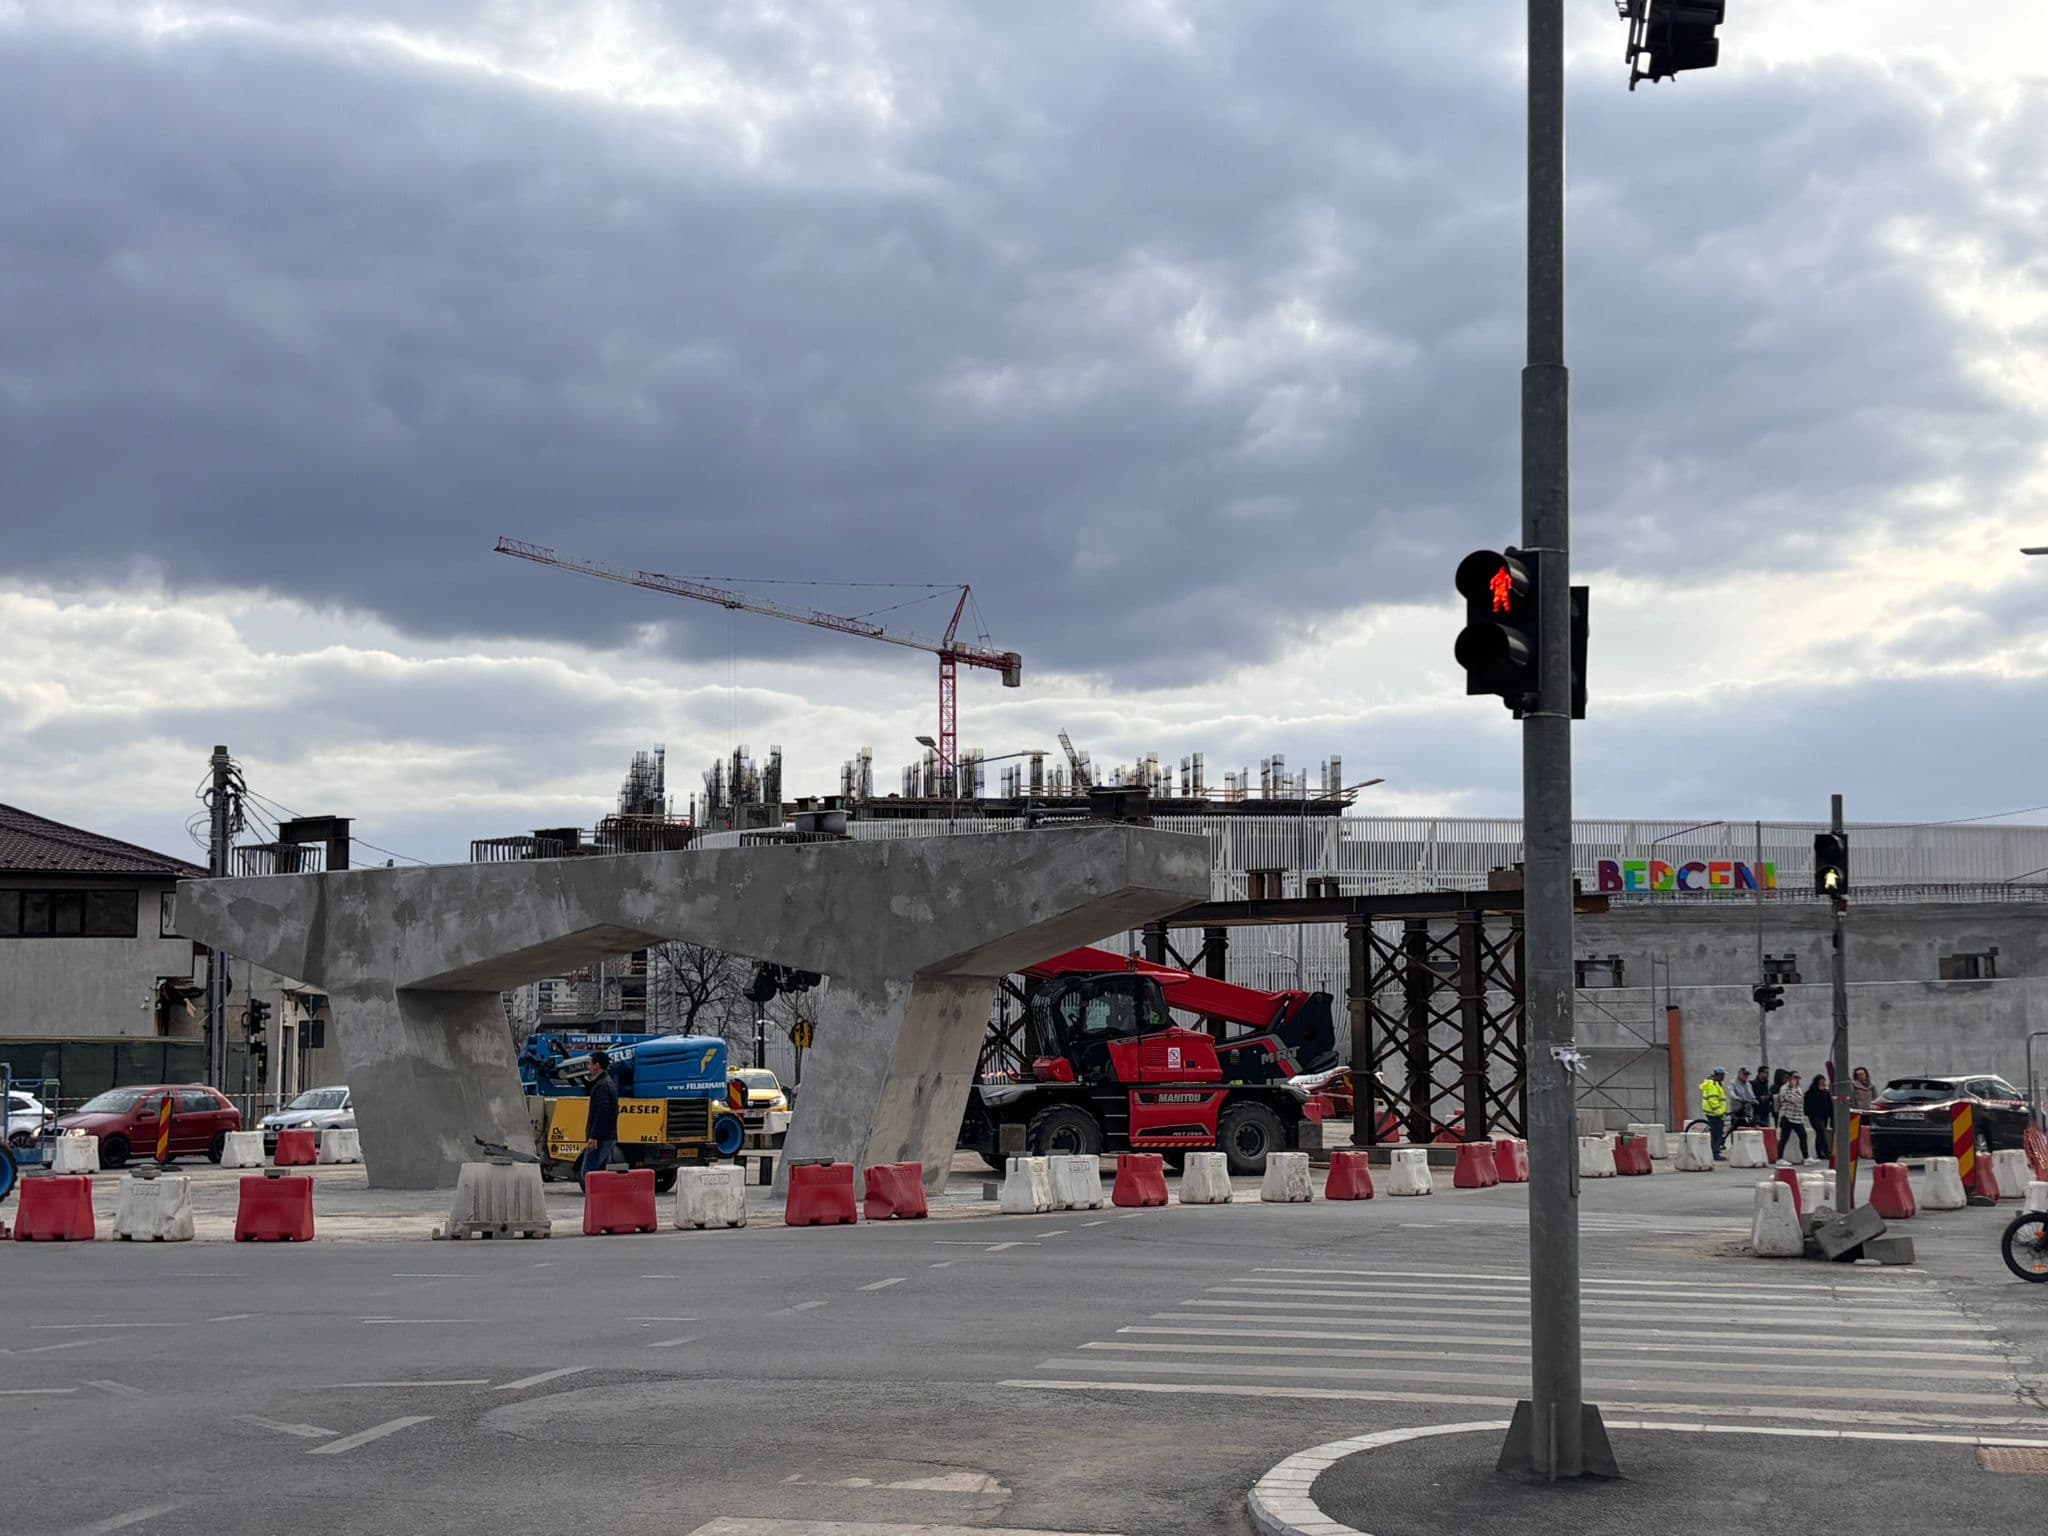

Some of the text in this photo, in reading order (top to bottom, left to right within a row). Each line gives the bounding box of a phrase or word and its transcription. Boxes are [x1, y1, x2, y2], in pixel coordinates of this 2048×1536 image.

[1261, 1046, 1300, 1064] MRT
[1158, 1093, 1202, 1103] MANITOU
[618, 1105, 660, 1114] AESER
